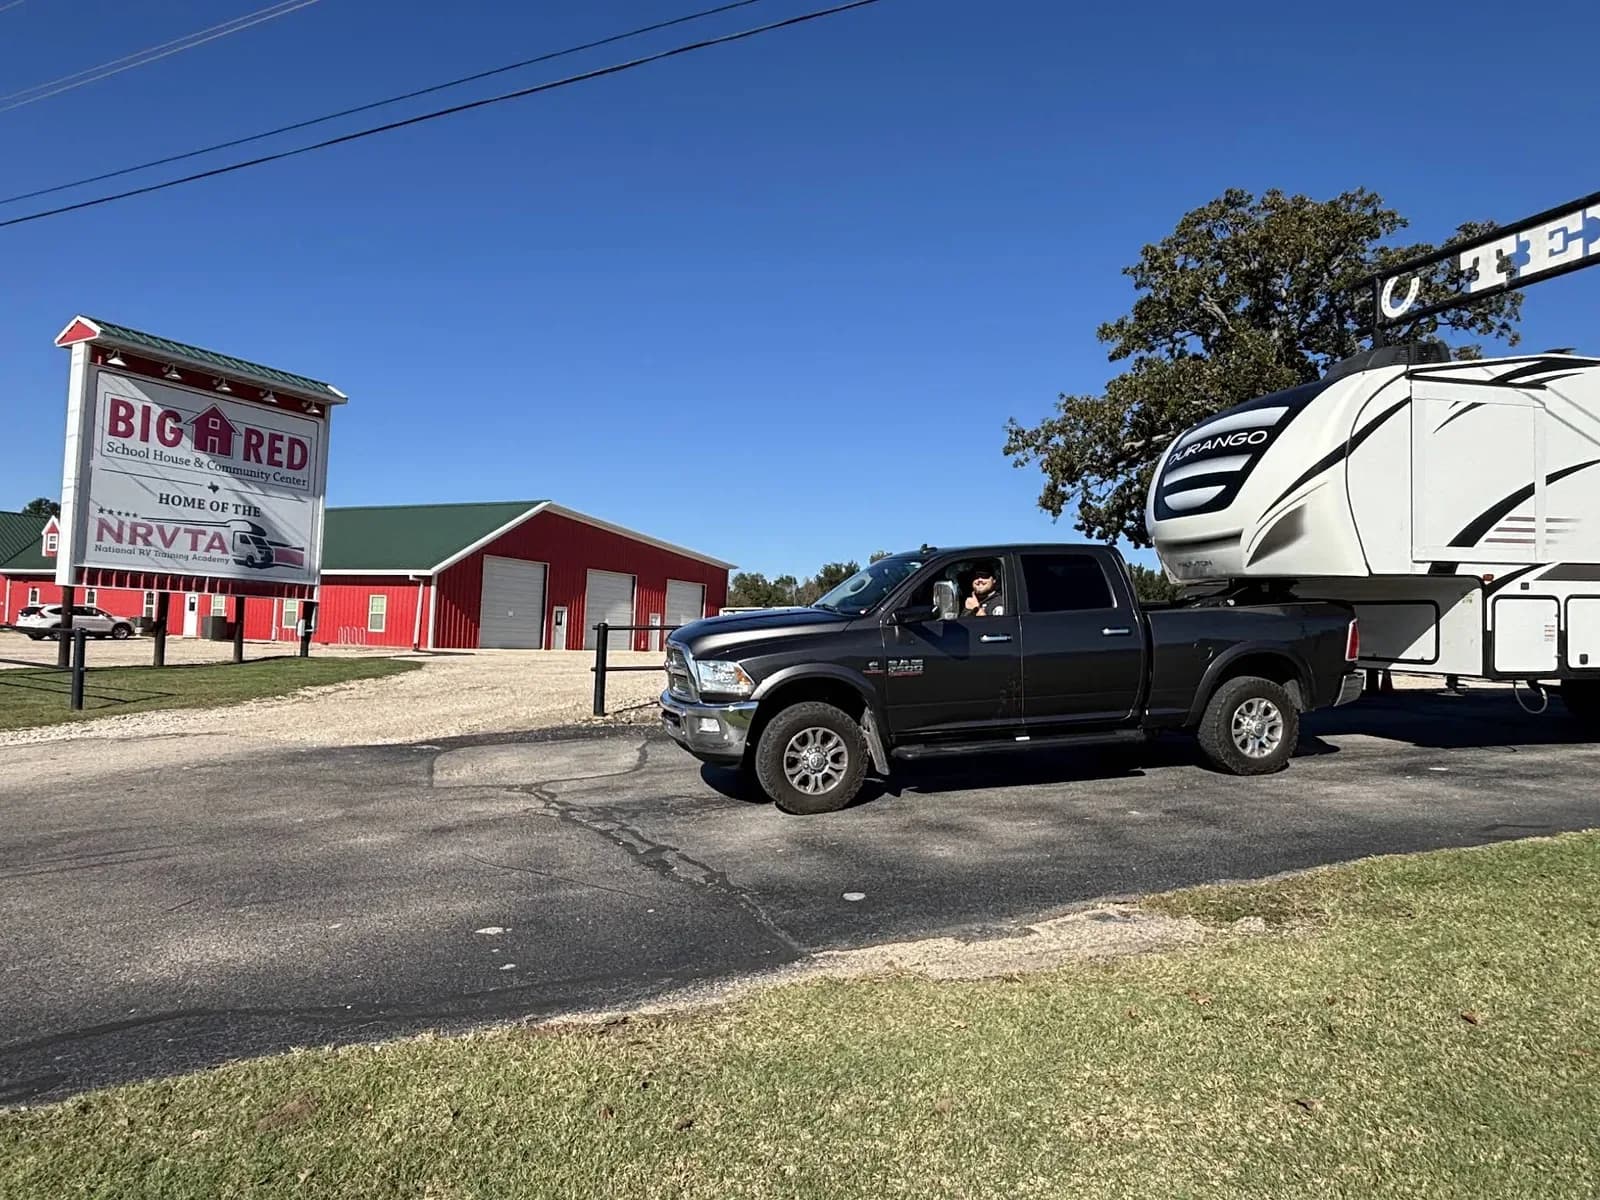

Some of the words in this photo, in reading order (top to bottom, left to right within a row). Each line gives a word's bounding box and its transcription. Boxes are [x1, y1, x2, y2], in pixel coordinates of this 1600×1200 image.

[1459, 203, 1600, 293] TE
[108, 398, 184, 448] BIG
[242, 427, 308, 471] RED
[1168, 430, 1268, 466] DURANGO
[106, 441, 150, 459] School
[153, 449, 191, 466] House
[193, 456, 204, 469] &
[206, 459, 271, 482] Community
[273, 471, 307, 486] Center
[158, 493, 206, 510] HOME
[209, 500, 230, 513] OF
[232, 503, 261, 518] THE
[94, 544, 136, 556] National
[138, 548, 152, 557] RV
[154, 549, 189, 562] Training
[191, 553, 230, 565] Academy
[95, 517, 230, 555] NRVTA
